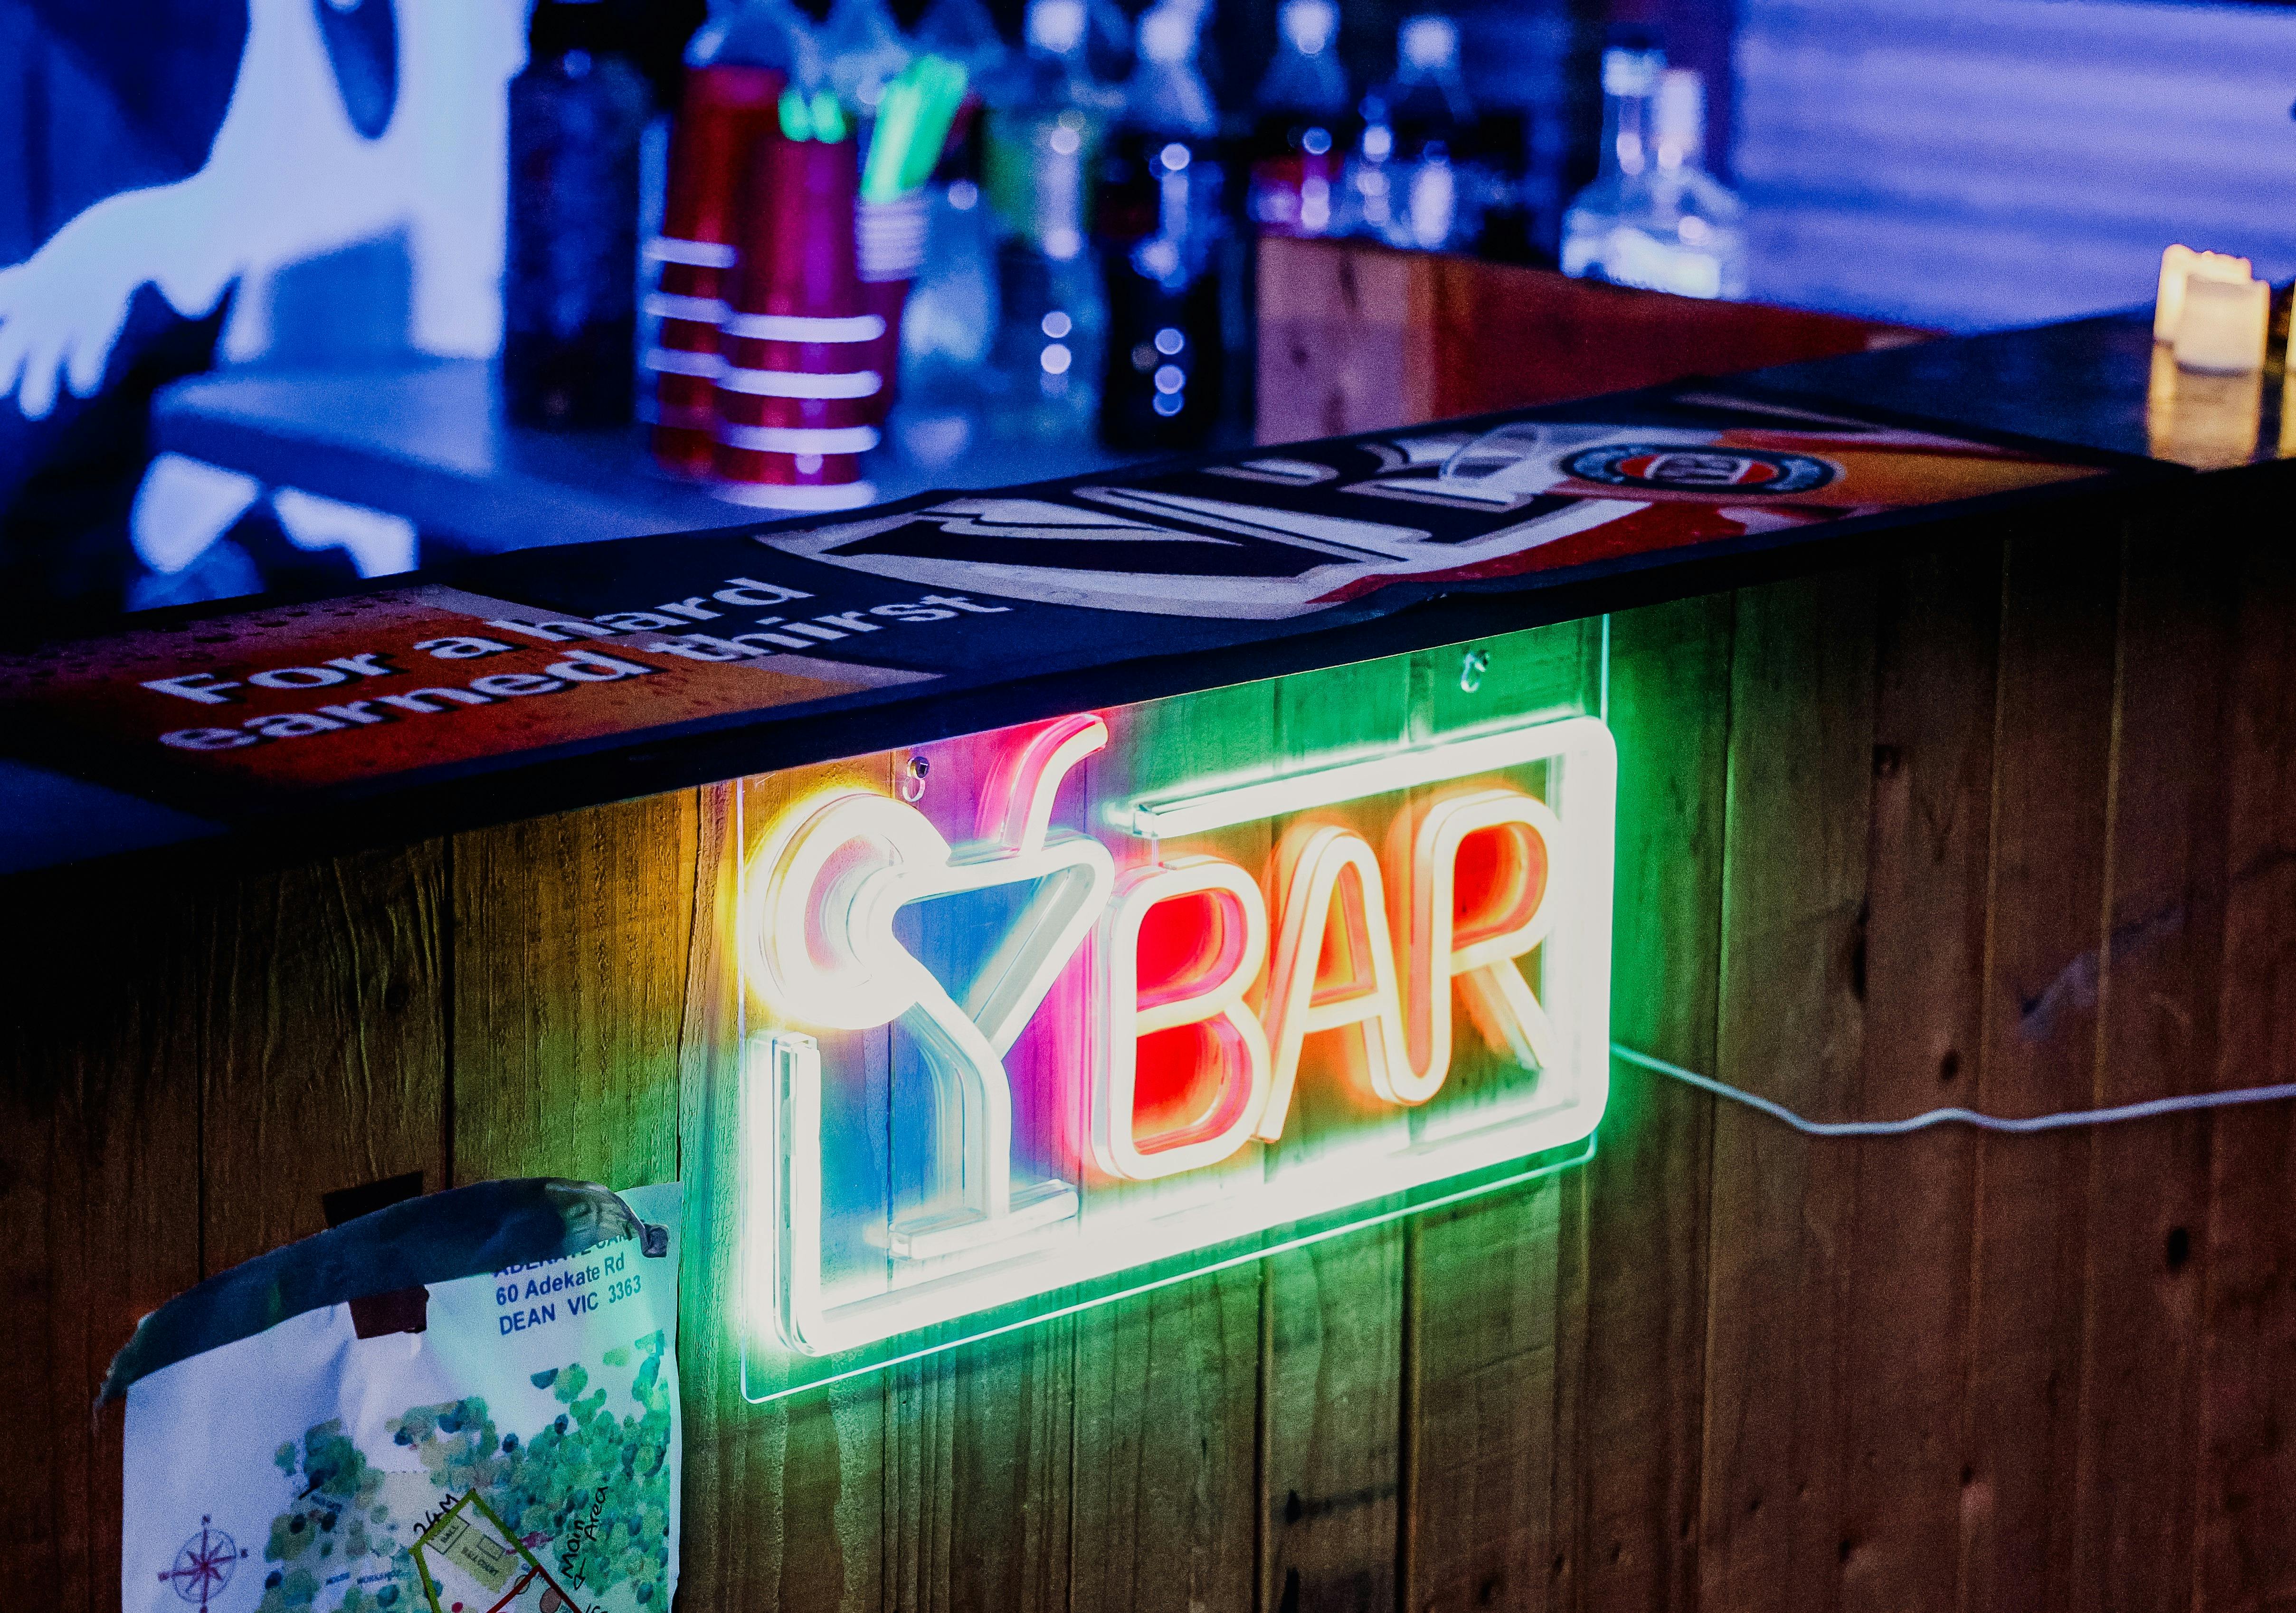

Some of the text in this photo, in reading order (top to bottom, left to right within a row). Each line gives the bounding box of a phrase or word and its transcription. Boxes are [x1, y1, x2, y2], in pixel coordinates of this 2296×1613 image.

[139, 577, 816, 704] For a hard
[158, 594, 1015, 750] earned thirst
[1091, 788, 1564, 1180] BAR
[495, 1283, 519, 1306] 60
[525, 1264, 600, 1300] Adekate
[604, 1251, 625, 1276] Rd
[499, 1274, 641, 1336] DEAN VIC 3363
[584, 1486, 609, 1542] Area
[561, 1520, 585, 1579] Main
